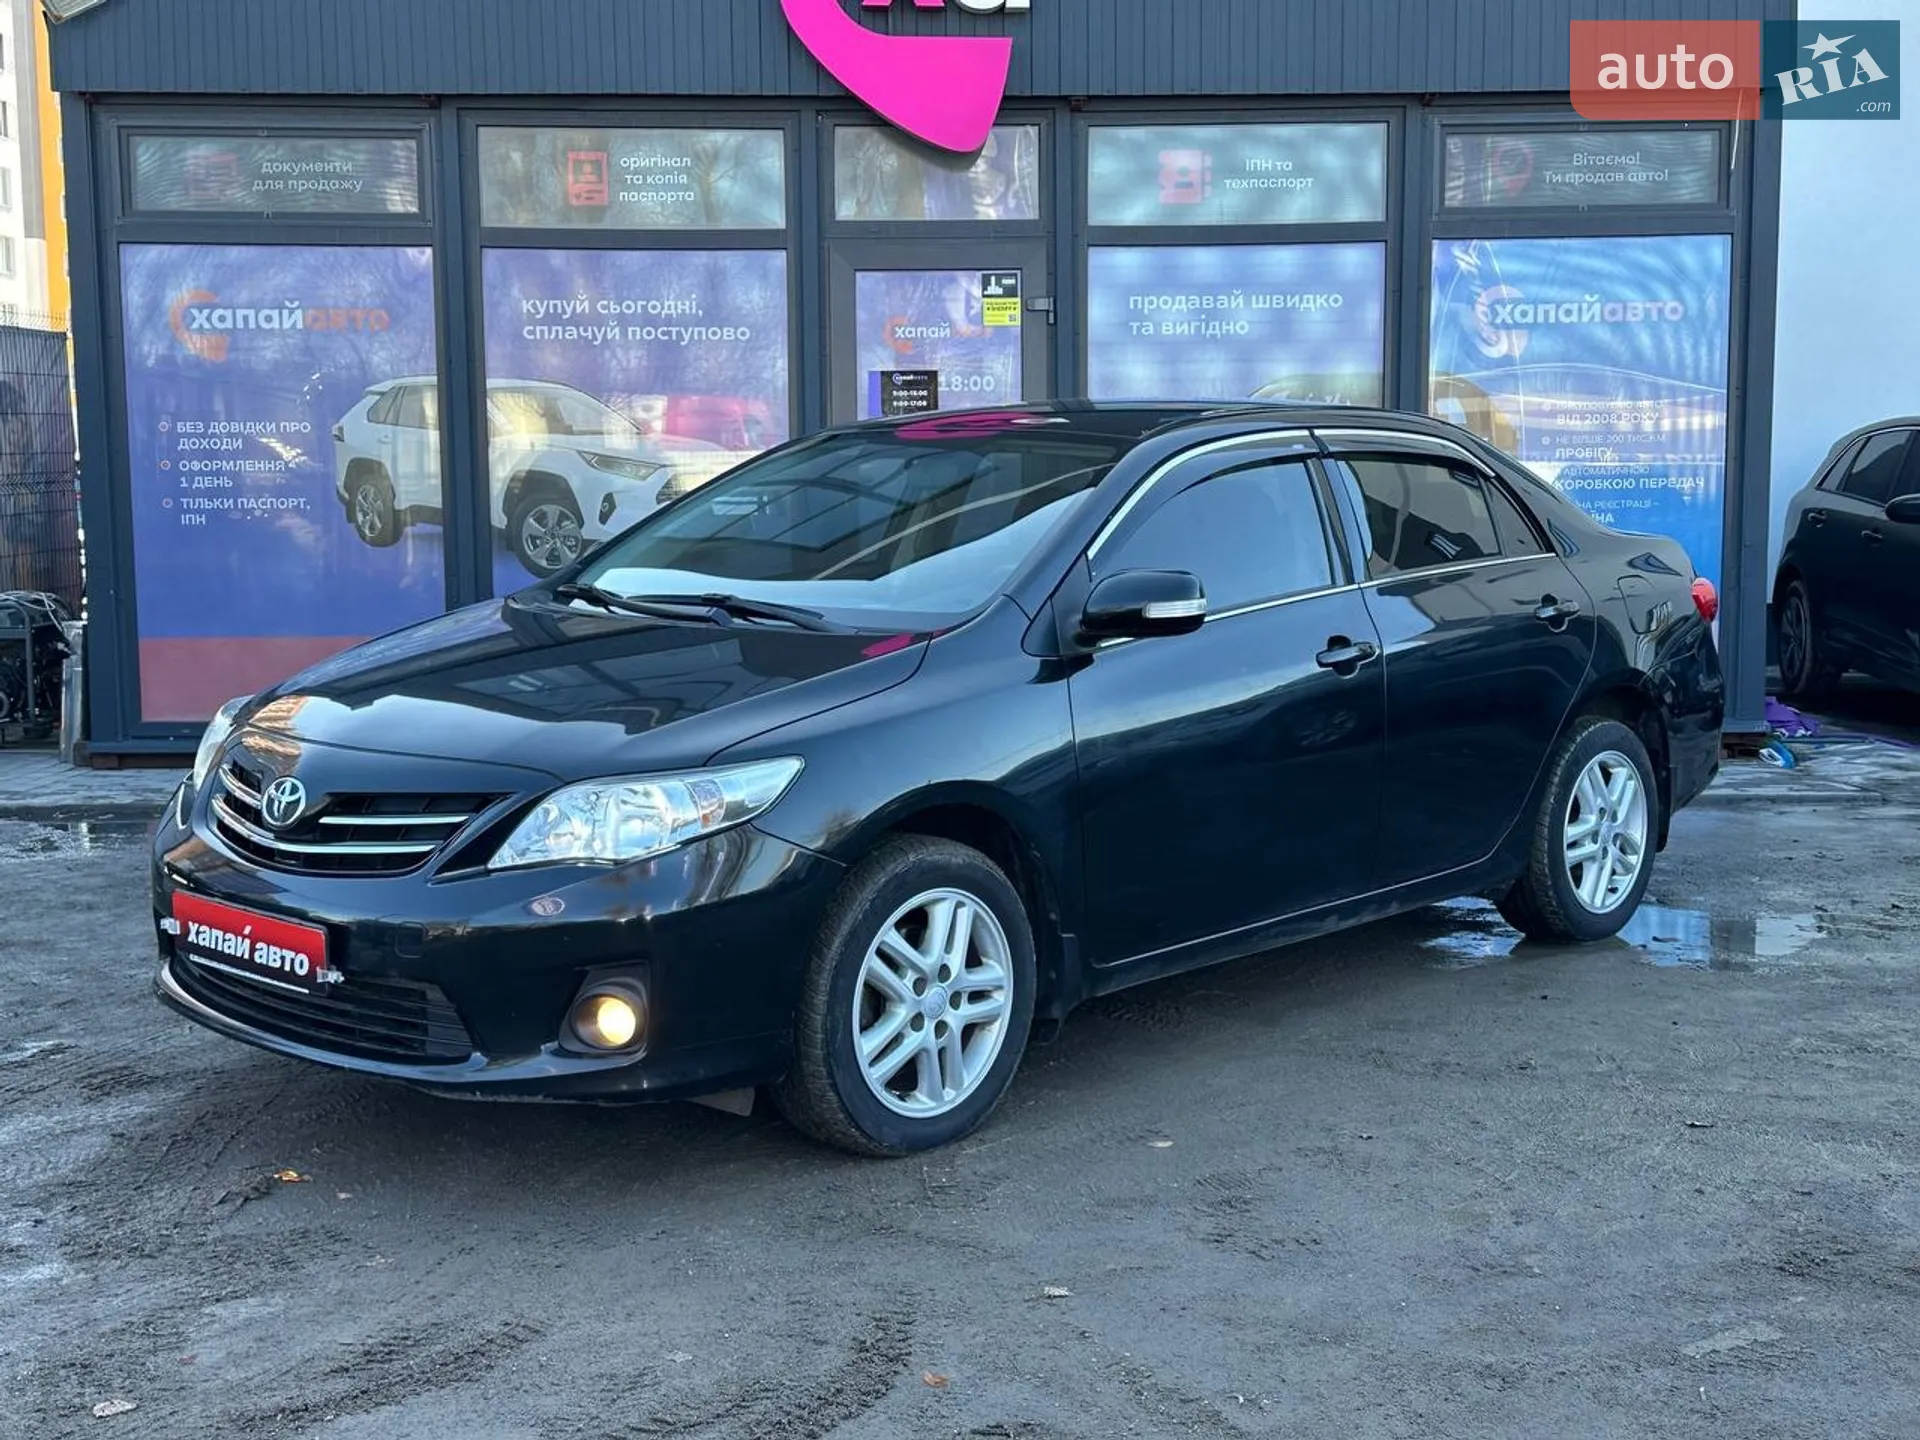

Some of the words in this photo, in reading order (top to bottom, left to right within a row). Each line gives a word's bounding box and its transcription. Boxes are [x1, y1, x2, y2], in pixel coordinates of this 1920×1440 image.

[620, 154, 691, 170] оригінал
[1246, 158, 1272, 171] ІПН
[1275, 161, 1293, 171] та
[1573, 152, 1640, 165] Вітаємо!
[261, 161, 352, 175] документи
[625, 174, 643, 184] та
[646, 171, 688, 184] копія
[1543, 170, 1561, 183] Ти
[1565, 171, 1624, 185] продав
[1627, 169, 1668, 181] авто!
[252, 180, 284, 192] для
[288, 179, 363, 193] продажу
[1224, 178, 1314, 191] техпаспорт
[619, 190, 695, 204] паспорта
[522, 292, 589, 318] купуй
[596, 294, 703, 317] сьогодні,
[1129, 289, 1244, 314] продавай
[1251, 293, 1343, 312] швидко
[523, 320, 620, 345] сплачуй
[627, 325, 750, 346] поступово
[1129, 322, 1154, 335] та
[1162, 315, 1249, 337] вигідно
[940, 374, 995, 392] 18:00
[1584, 413, 1618, 425] 2008
[1621, 411, 1659, 424] РОКУ
[177, 421, 204, 433] БЕЗ
[208, 421, 276, 435] ДОВІДКИ
[280, 421, 311, 433] ПРО
[177, 438, 242, 451] ДОХОДИ
[179, 460, 285, 471] ОФОРМЛЕННЯ
[1563, 466, 1649, 477] АВТОМАТИЧНОЮ
[180, 476, 188, 487] 1
[192, 476, 233, 489] ДЕНЬ
[1555, 479, 1635, 491] КОРОБКОЮ
[1640, 477, 1705, 490] ПЕРЕДАЧ
[180, 498, 234, 509] ТІЛЬКИ
[238, 498, 311, 510] ПАСПОРТ,
[181, 514, 206, 525] ІПН
[253, 941, 310, 976] авто
